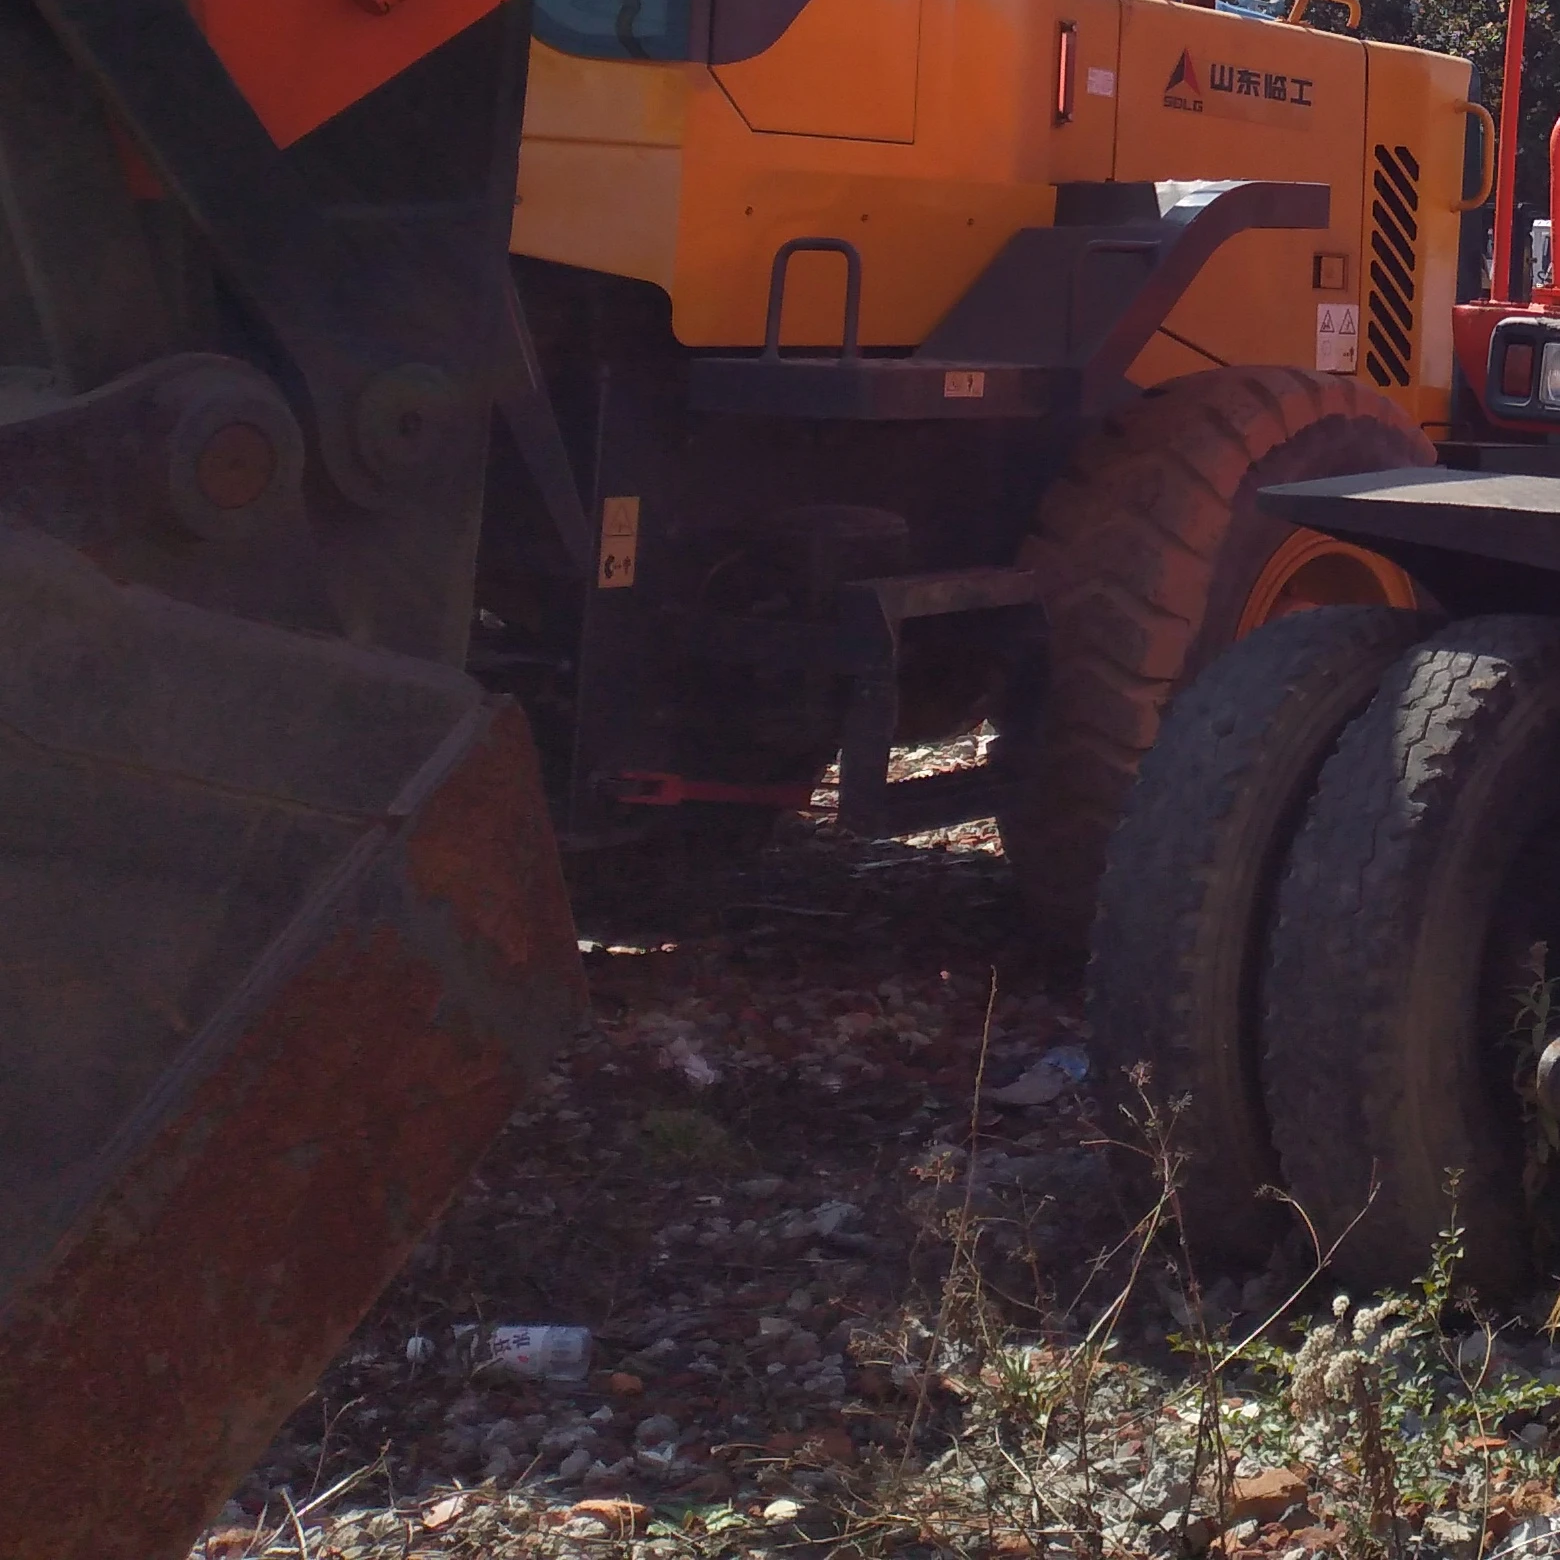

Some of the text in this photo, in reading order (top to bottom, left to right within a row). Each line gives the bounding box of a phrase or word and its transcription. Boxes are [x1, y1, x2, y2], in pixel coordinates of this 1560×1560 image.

[1209, 63, 1313, 107] 山东临工
[1163, 95, 1203, 113] SDLG
